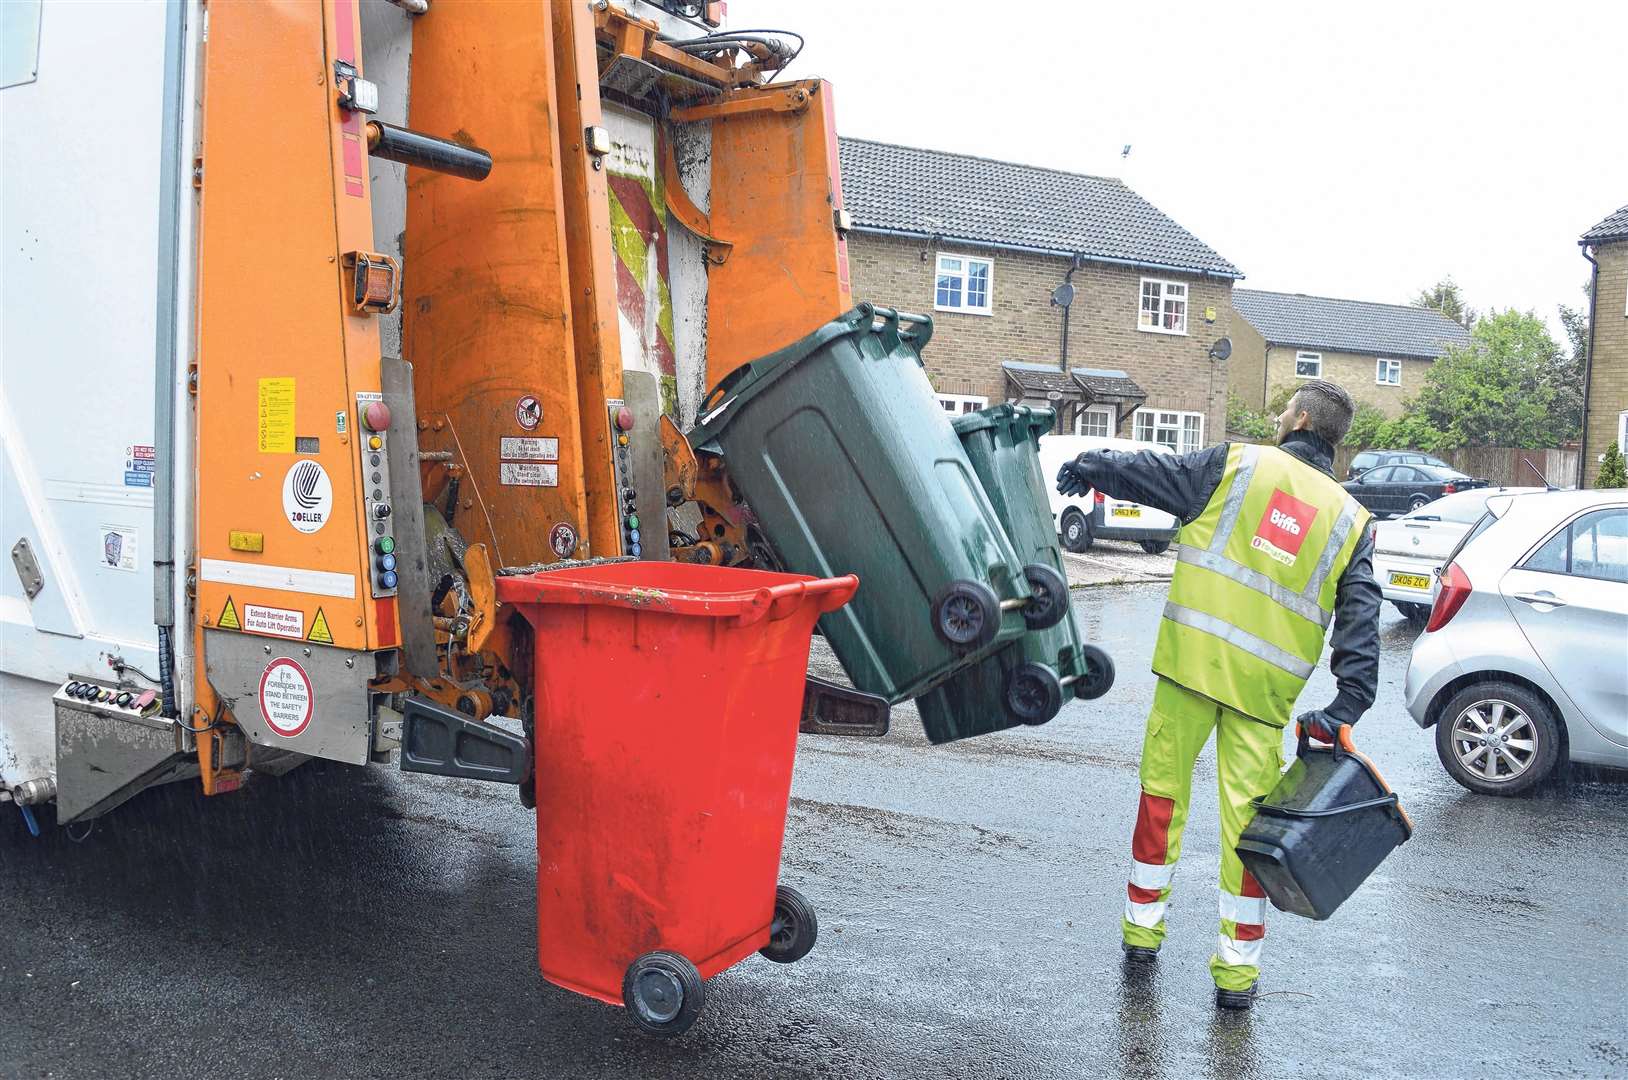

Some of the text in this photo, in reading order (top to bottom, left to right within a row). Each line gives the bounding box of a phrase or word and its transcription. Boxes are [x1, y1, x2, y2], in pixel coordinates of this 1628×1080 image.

[292, 512, 322, 522] ZOELLER
[1270, 508, 1300, 535] Biffa
[250, 609, 298, 622] Extend Barrier Arms
[256, 620, 266, 628] Auto
[268, 622, 276, 630] Lift
[276, 622, 300, 632] Operation
[268, 681, 296, 690] FORBIDDEN
[265, 690, 308, 702] STAND BETWEEN
[282, 702, 302, 711] SAFETY
[272, 712, 300, 721] BARRIERS
